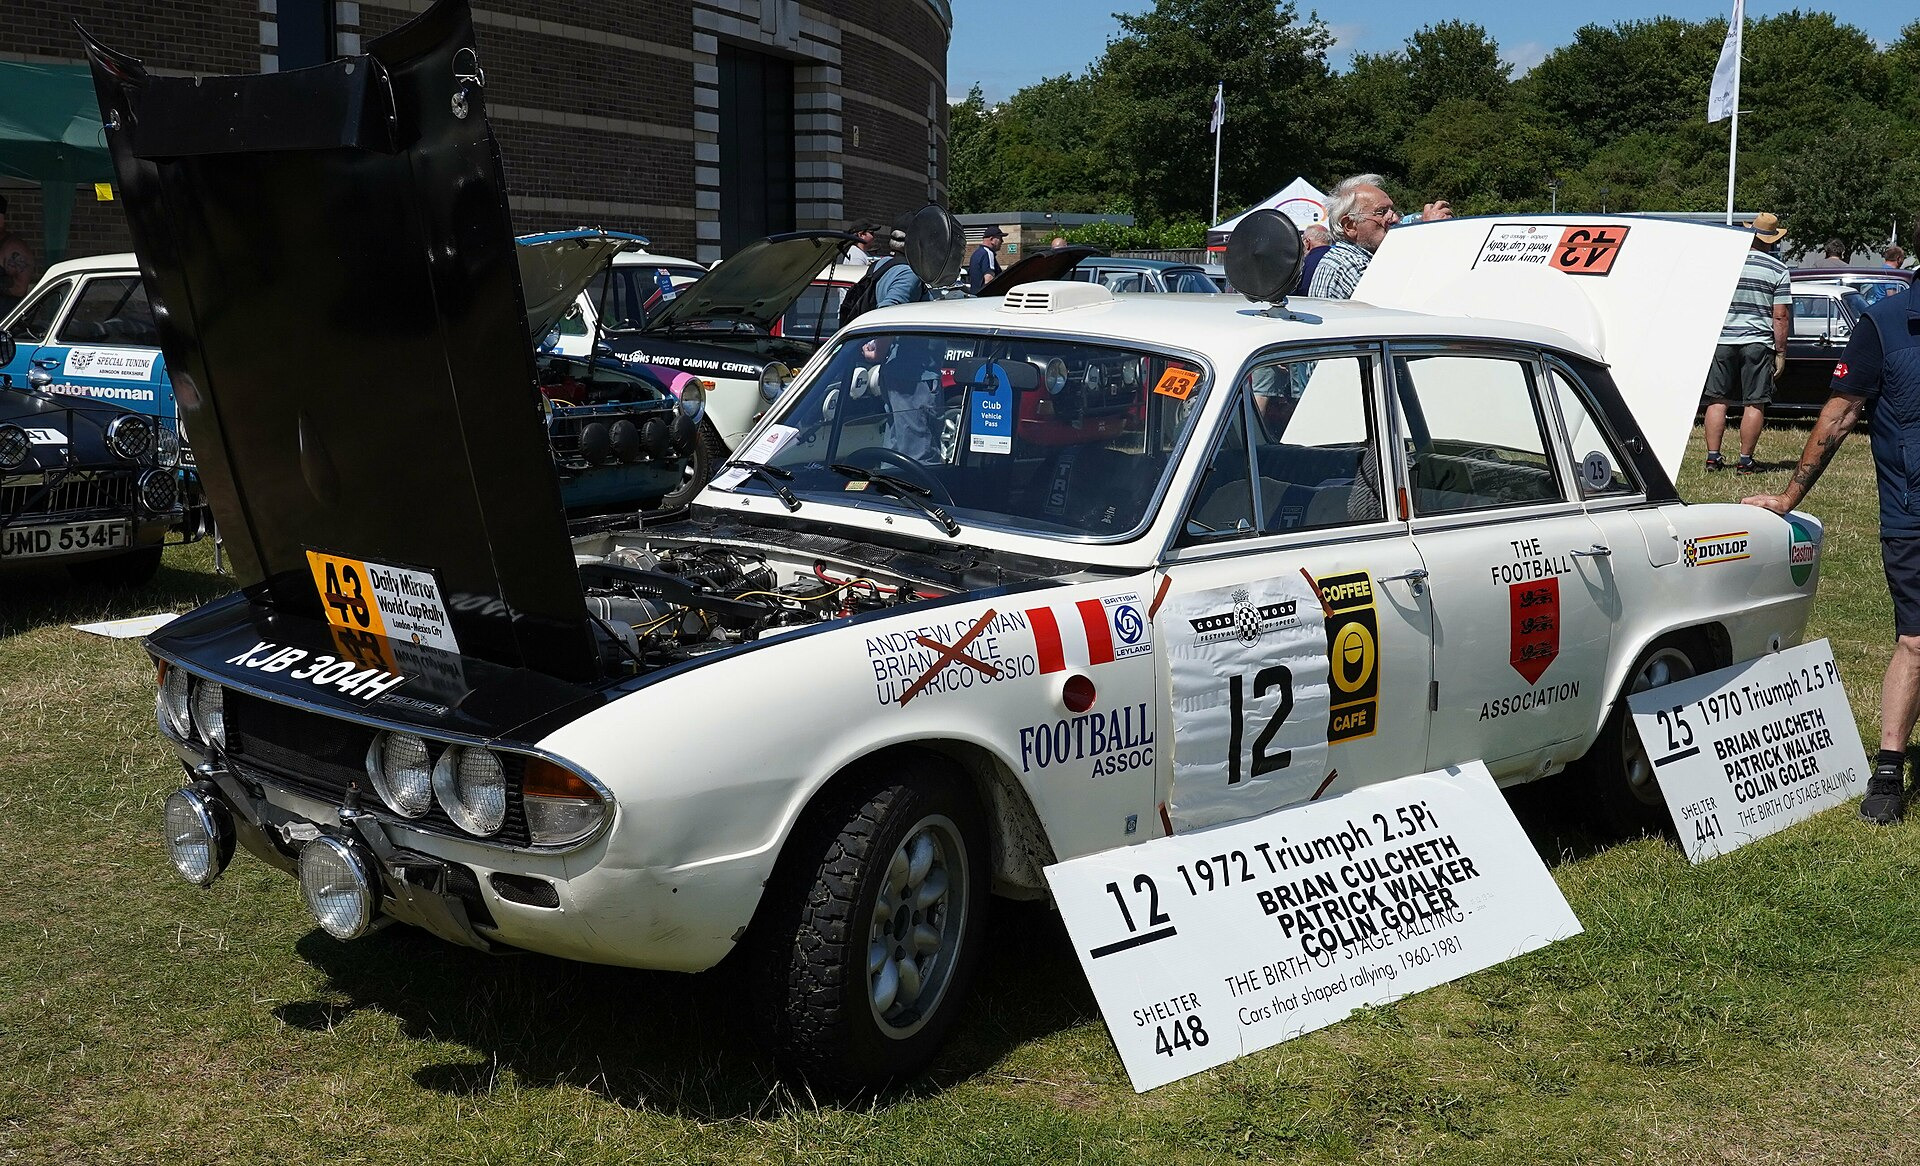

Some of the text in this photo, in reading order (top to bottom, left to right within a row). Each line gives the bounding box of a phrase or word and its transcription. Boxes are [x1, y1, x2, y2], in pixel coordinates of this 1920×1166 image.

[1487, 240, 1552, 252] World Cup Rally
[1560, 230, 1616, 267] 43
[97, 357, 150, 368] SPECIAL TUNING
[652, 355, 681, 367] MOTOR
[683, 358, 719, 370] CARAVAN
[944, 349, 974, 361] RITIS
[1161, 375, 1190, 396] 43
[981, 412, 1003, 420] Vehicle
[982, 400, 1002, 410] Club
[985, 420, 999, 428] Pass
[1590, 460, 1604, 480] 25
[58, 524, 125, 550] 534F
[1510, 538, 1543, 559] THE
[1698, 540, 1748, 559] DUNLOP
[1792, 544, 1814, 564] Castrol
[370, 568, 436, 600] Daily Mirror
[1491, 555, 1572, 586] FOOTBALL
[325, 562, 371, 628] 43
[1104, 594, 1138, 605] BRITISH
[1321, 580, 1372, 603] COFFEE
[377, 595, 445, 627] World Cup Rally
[866, 623, 951, 658] ANDREW
[1200, 630, 1236, 642] FESTIVAL
[1275, 618, 1295, 627] SPEED
[873, 649, 933, 682] BRIAN
[1116, 644, 1151, 657] LEYLAND
[225, 641, 405, 701] XJB 304H
[1479, 680, 1580, 722] ASSOCIATION
[1697, 690, 1742, 726] 1970
[1741, 671, 1803, 711] Triumph
[1801, 664, 1825, 693] 2.5
[1228, 664, 1294, 785] 12
[1333, 709, 1367, 732] CAFÉ
[1656, 704, 1694, 751] 25
[1713, 707, 1826, 761] BRIAN CULCHETH
[1019, 702, 1154, 773] FOOTBALL
[1091, 747, 1154, 779] ASSOC
[1723, 728, 1834, 783] PATRICK WALKER
[1734, 755, 1820, 803] COLIN GOLER
[1681, 796, 1718, 820] SHELTER
[1738, 767, 1856, 828] THE BIRTH OF STAGE RALLYING
[1695, 813, 1723, 843] 441
[1177, 800, 1439, 896] 1972 Triumph 2.5Pi
[1256, 835, 1461, 916] BRIAN CULCHETH
[1106, 874, 1171, 933] 12
[1277, 856, 1481, 939] PATRICK WALKER
[1300, 913, 1379, 958] COLIN
[1380, 887, 1460, 930] GOLER
[1225, 970, 1262, 998] THE
[1263, 950, 1312, 986] BIRTH
[1314, 945, 1338, 968] OF
[1344, 926, 1394, 960] STAGE
[1395, 907, 1465, 942] RALLYING
[1238, 934, 1463, 1027] Cars that shaped rallying, 1960-1981
[1132, 991, 1202, 1028] SHELTER
[1155, 1014, 1210, 1058] 448
